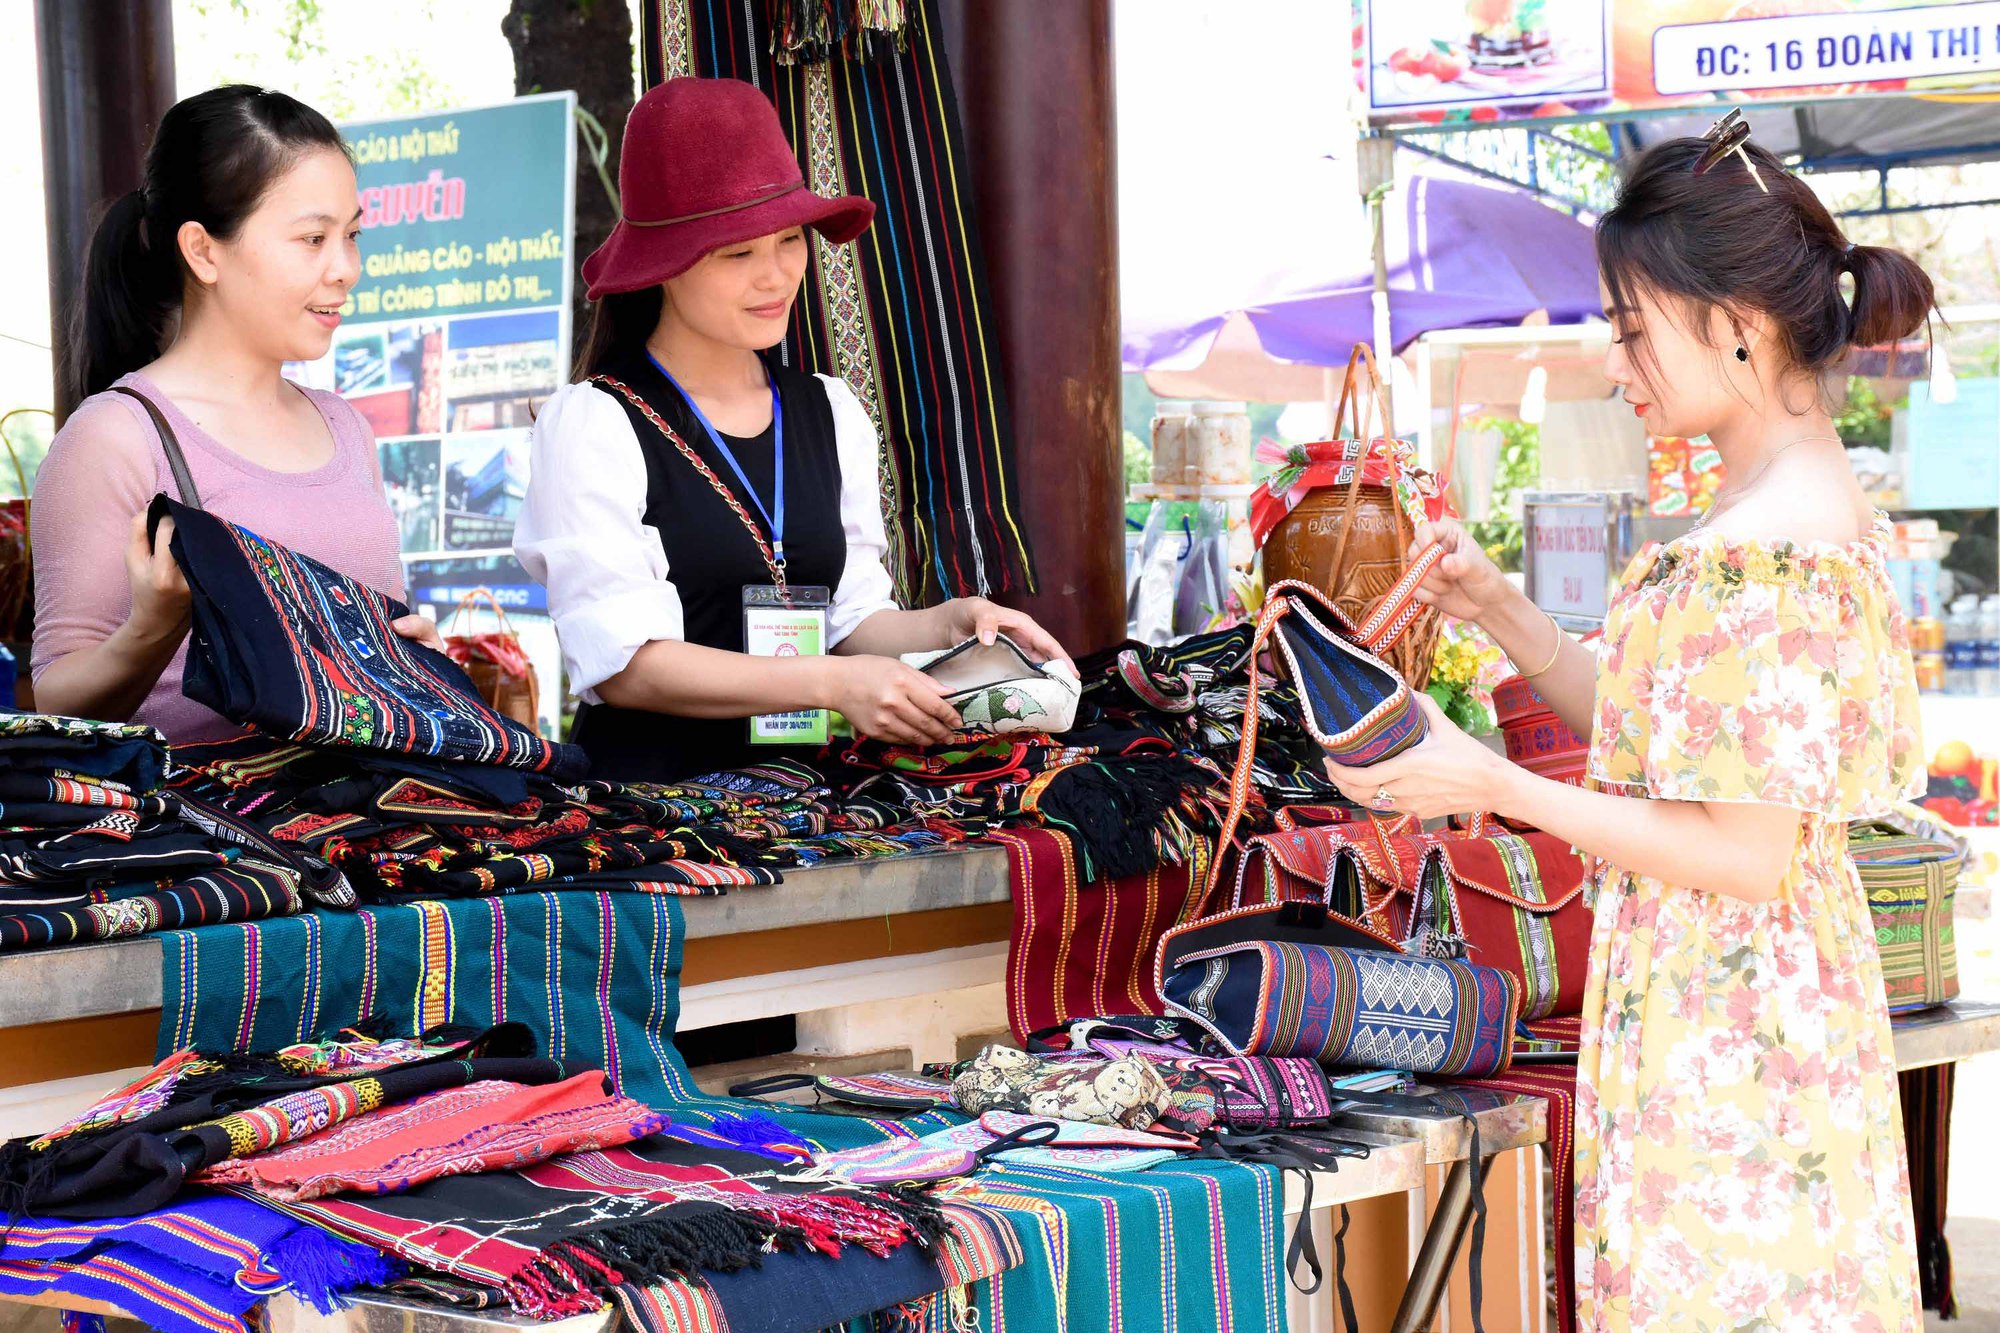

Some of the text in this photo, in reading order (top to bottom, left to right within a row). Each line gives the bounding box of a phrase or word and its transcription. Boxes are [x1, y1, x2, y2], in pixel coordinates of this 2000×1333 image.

[1696, 45, 1750, 77] ĐC:
[1765, 40, 1803, 72] 16
[1928, 26, 1981, 63] THỊ
[427, 121, 460, 156] THẤT
[366, 244, 431, 277] QUẢNG
[433, 240, 473, 271] CÁO
[486, 236, 517, 268] NỘI
[357, 286, 380, 315] TRÍ
[382, 284, 434, 312] CÔNG
[436, 278, 482, 308] TRÌNH
[486, 273, 511, 303] ĐÔ
